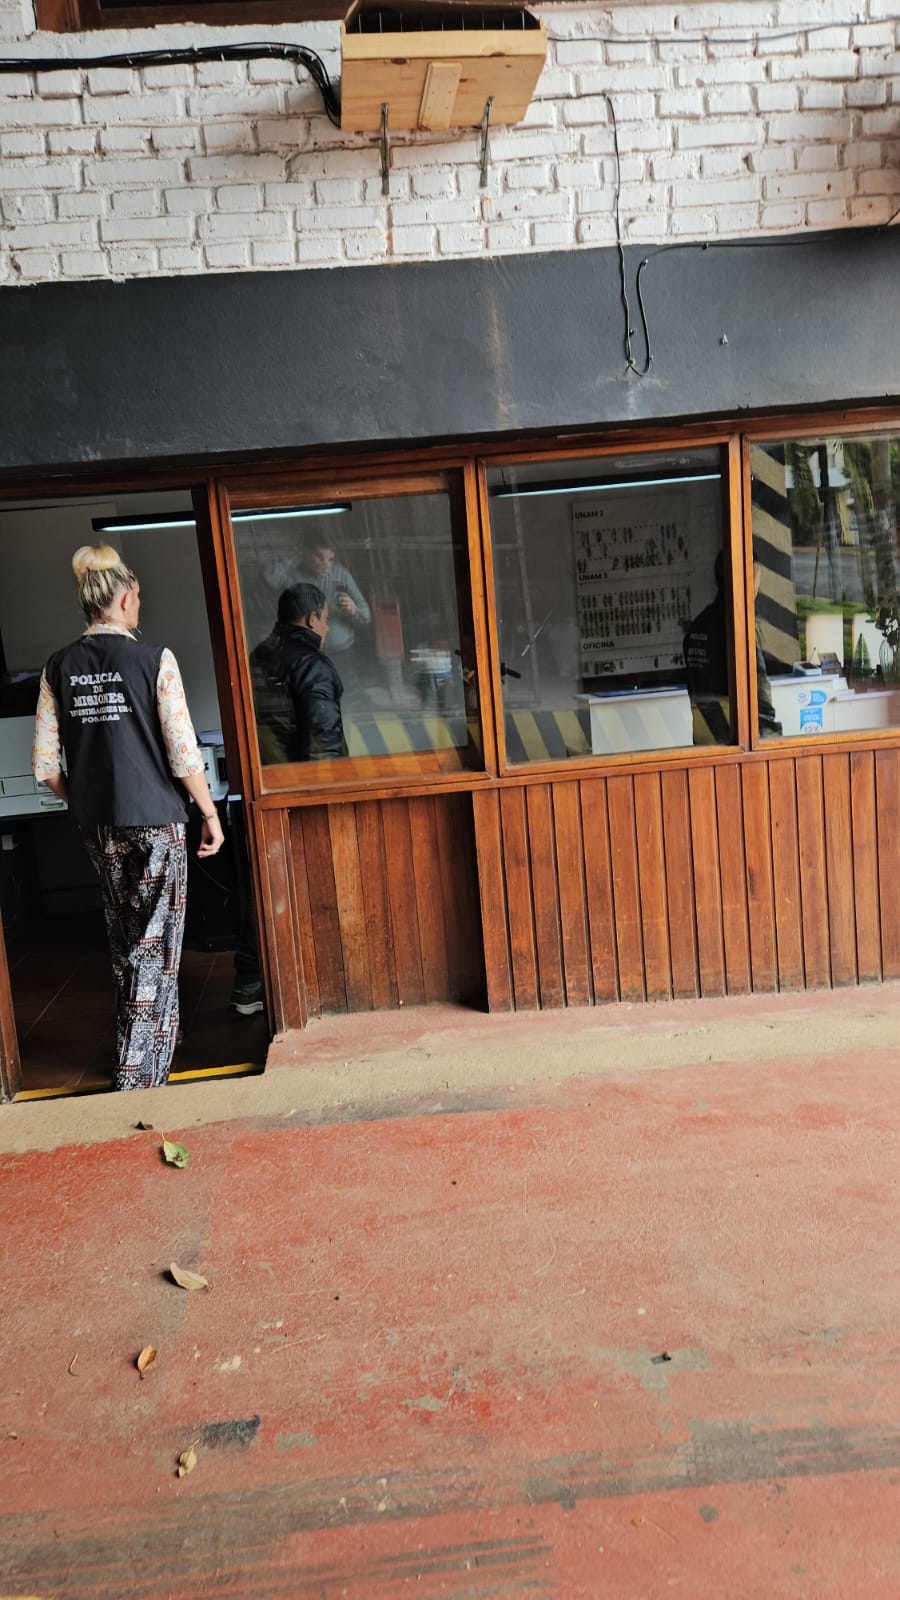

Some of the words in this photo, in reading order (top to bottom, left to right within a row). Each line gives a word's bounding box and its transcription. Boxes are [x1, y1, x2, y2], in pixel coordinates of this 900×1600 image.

[575, 511, 599, 520] UNAM
[579, 573, 602, 581] UNAM
[583, 641, 615, 650] OFICINA
[70, 672, 122, 686] POLICIA
[93, 685, 103, 693] DE
[73, 693, 125, 706] MISIONES
